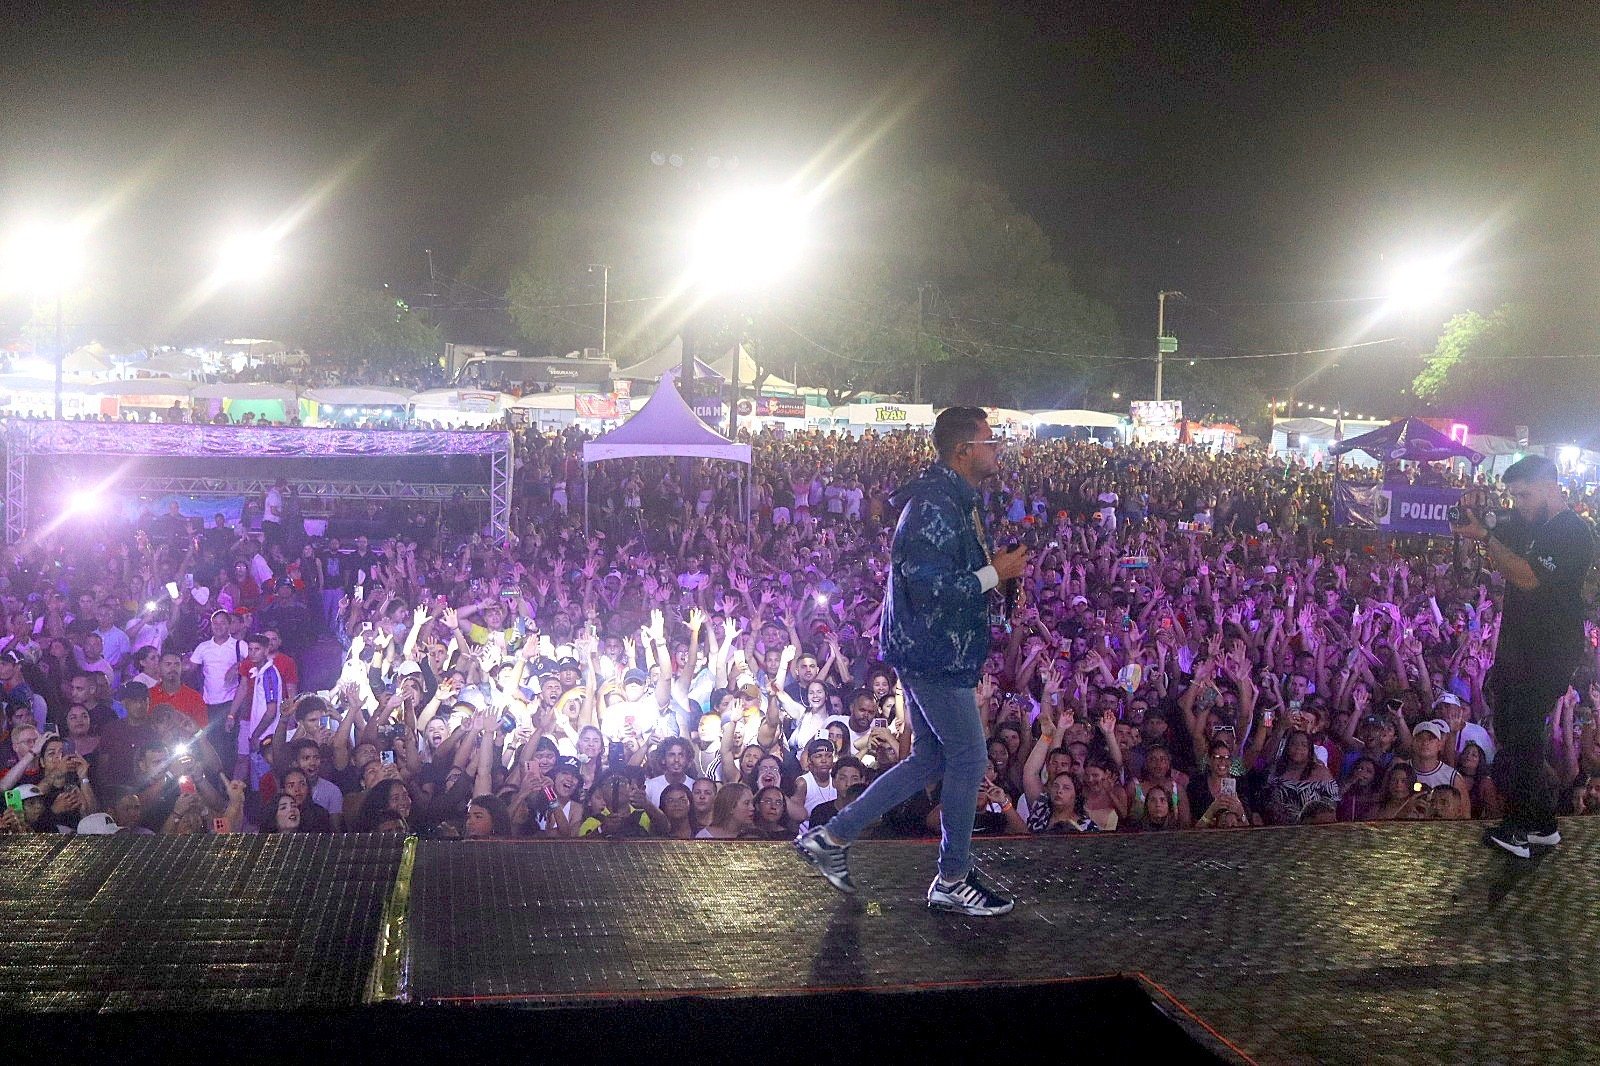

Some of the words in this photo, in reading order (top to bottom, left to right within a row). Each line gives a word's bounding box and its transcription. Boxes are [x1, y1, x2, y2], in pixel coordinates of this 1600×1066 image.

[693, 406, 712, 417] ICIA
[876, 407, 907, 421] IVAN
[1400, 501, 1449, 521] POLICI
